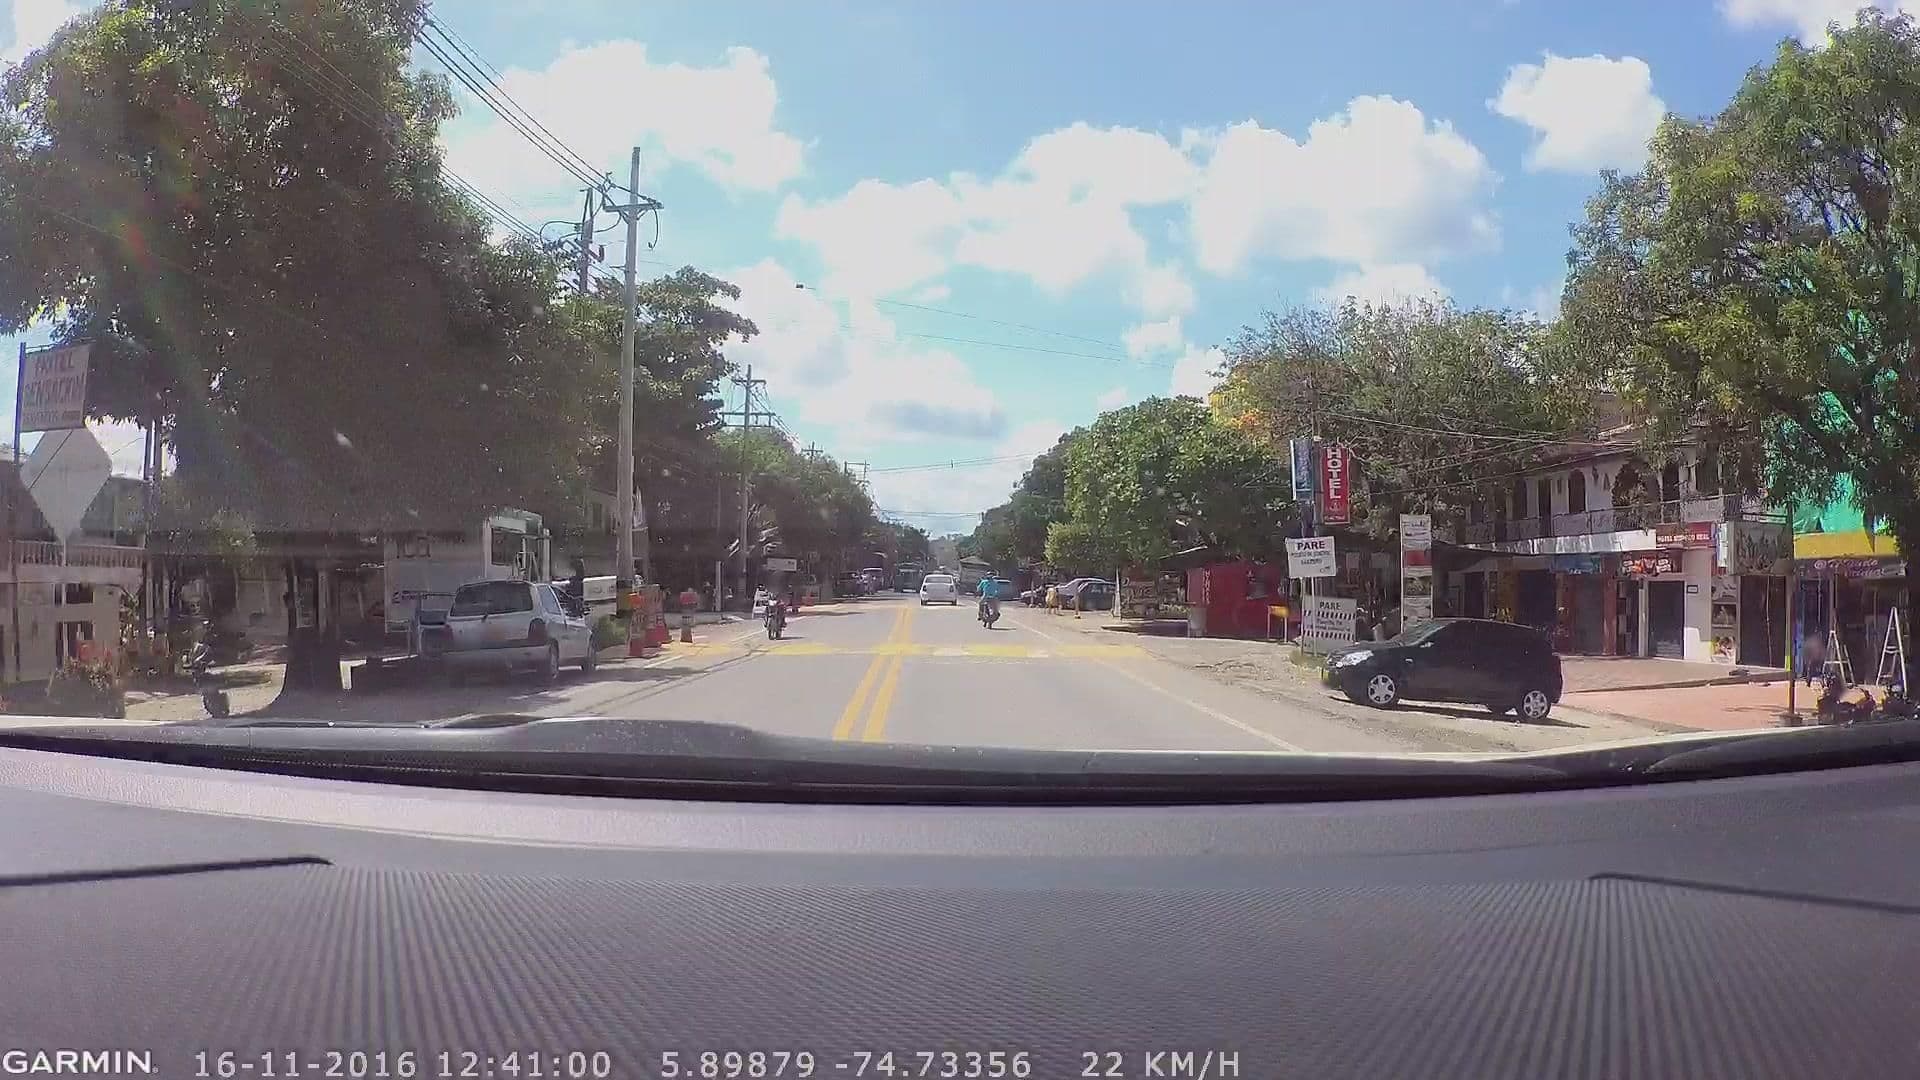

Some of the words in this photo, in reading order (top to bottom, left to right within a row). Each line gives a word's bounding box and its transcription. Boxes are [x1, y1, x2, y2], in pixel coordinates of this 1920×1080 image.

[1326, 448, 1343, 499] HOTEL
[1297, 540, 1326, 551] PARE
[1319, 601, 1342, 611] PARE
